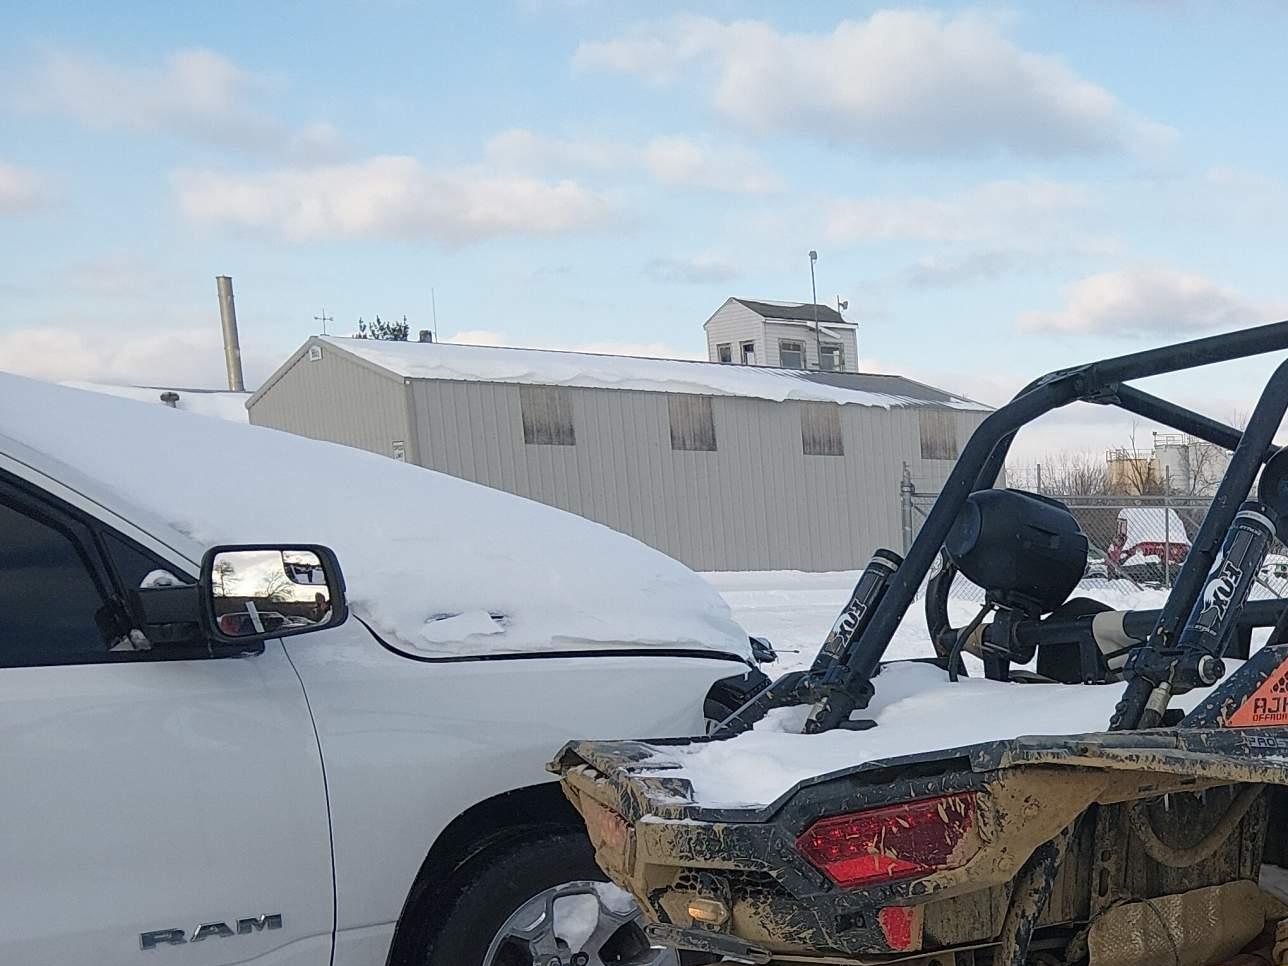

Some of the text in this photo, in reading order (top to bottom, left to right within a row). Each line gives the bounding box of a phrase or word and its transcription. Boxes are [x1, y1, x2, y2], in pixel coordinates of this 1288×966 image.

[1206, 560, 1243, 621] FOX
[836, 598, 868, 648] FOX
[139, 912, 283, 951] RAM
